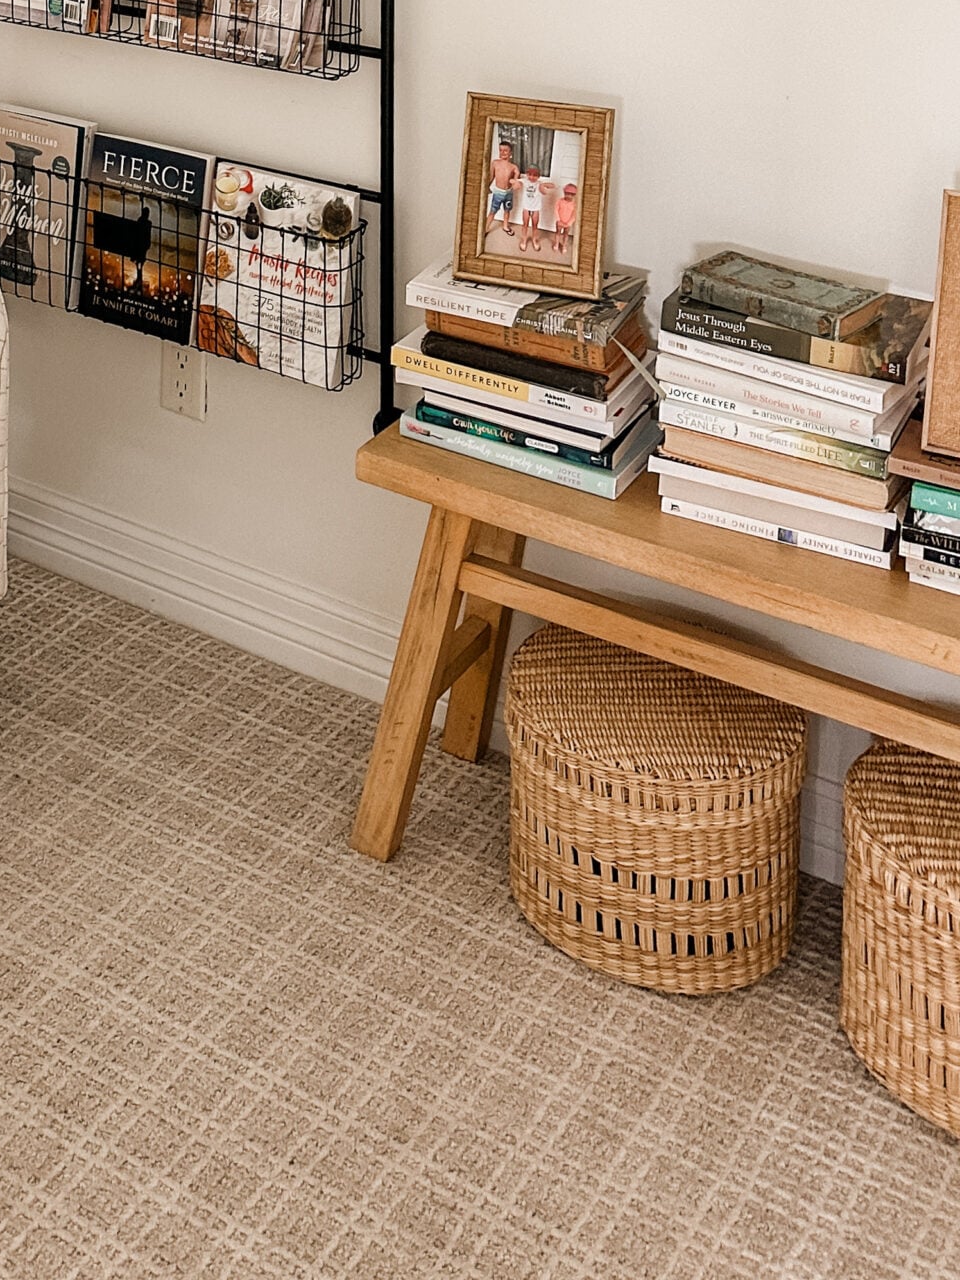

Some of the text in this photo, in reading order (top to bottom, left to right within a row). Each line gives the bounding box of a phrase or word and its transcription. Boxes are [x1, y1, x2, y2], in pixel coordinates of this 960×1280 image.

[102, 150, 196, 195] FIERCE
[0, 198, 66, 246] Women
[295, 258, 339, 287] Recipes
[92, 294, 178, 328] JENNIFER COWART
[252, 294, 275, 312] 375
[416, 295, 507, 321] RESILIENT HOPE
[516, 318, 554, 330] CHRISTINE
[676, 308, 746, 333] Jesus Through
[675, 322, 772, 352] Middle Eastern Eyes
[405, 356, 519, 393] DWELL DIFFERENTLY
[752, 364, 770, 376] YOU
[770, 370, 782, 379] OF
[783, 373, 806, 386] BOSS
[805, 380, 822, 390] THE
[822, 384, 840, 397] NOT
[840, 390, 848, 398] IS
[544, 393, 566, 402] Abbott
[668, 387, 737, 410] JOYCE MEYER
[742, 390, 822, 419] The Stories We Tell
[848, 393, 872, 406] FEAR
[474, 422, 499, 438] your
[499, 428, 516, 444] life
[676, 413, 726, 435] STANLEY
[760, 412, 794, 425] answer
[802, 422, 838, 436] anxiety
[749, 431, 764, 441] THE
[816, 446, 843, 462] LIFE
[495, 452, 533, 472] uniquely
[535, 462, 554, 476] you
[558, 468, 580, 478] JOYCE
[694, 510, 776, 538] FINDING PEACE
[802, 536, 883, 564] CHARLES STANLEY
[914, 534, 929, 545] The
[918, 564, 946, 576] CALM
